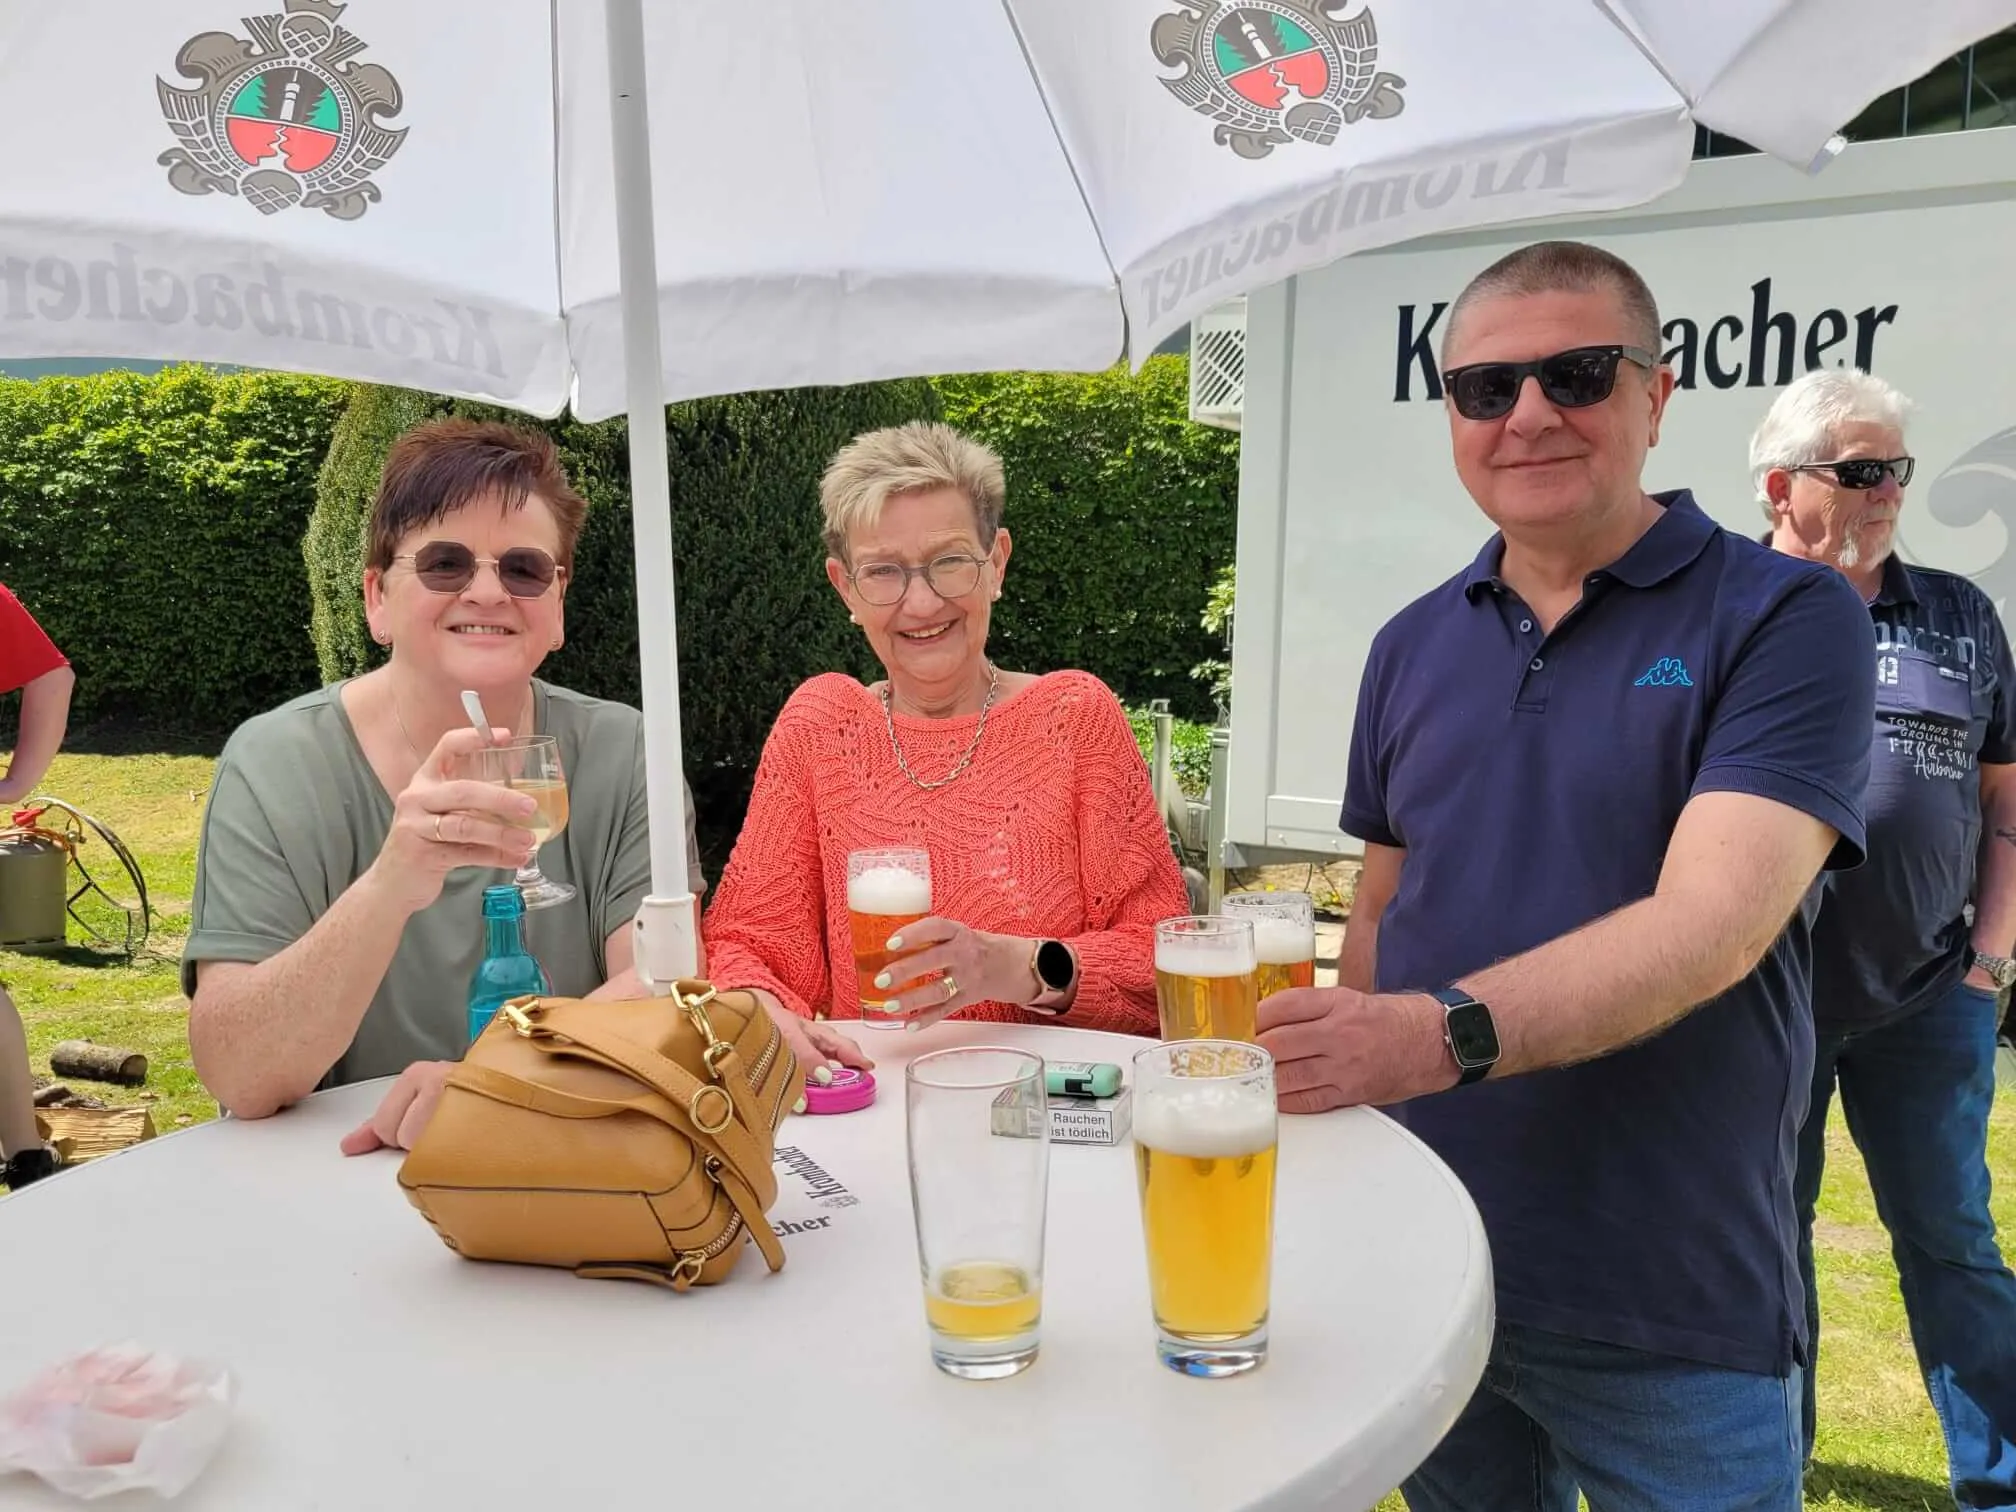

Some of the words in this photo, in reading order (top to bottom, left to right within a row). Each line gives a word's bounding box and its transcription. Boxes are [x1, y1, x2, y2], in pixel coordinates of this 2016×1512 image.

[1888, 717, 1949, 736] TOWARDS
[1952, 729, 1969, 740] THE
[1900, 728, 1950, 746] GROUND
[1053, 1112, 1106, 1125] Rauchen
[1051, 1126, 1065, 1137] ist
[1068, 1126, 1110, 1140] tödlich
